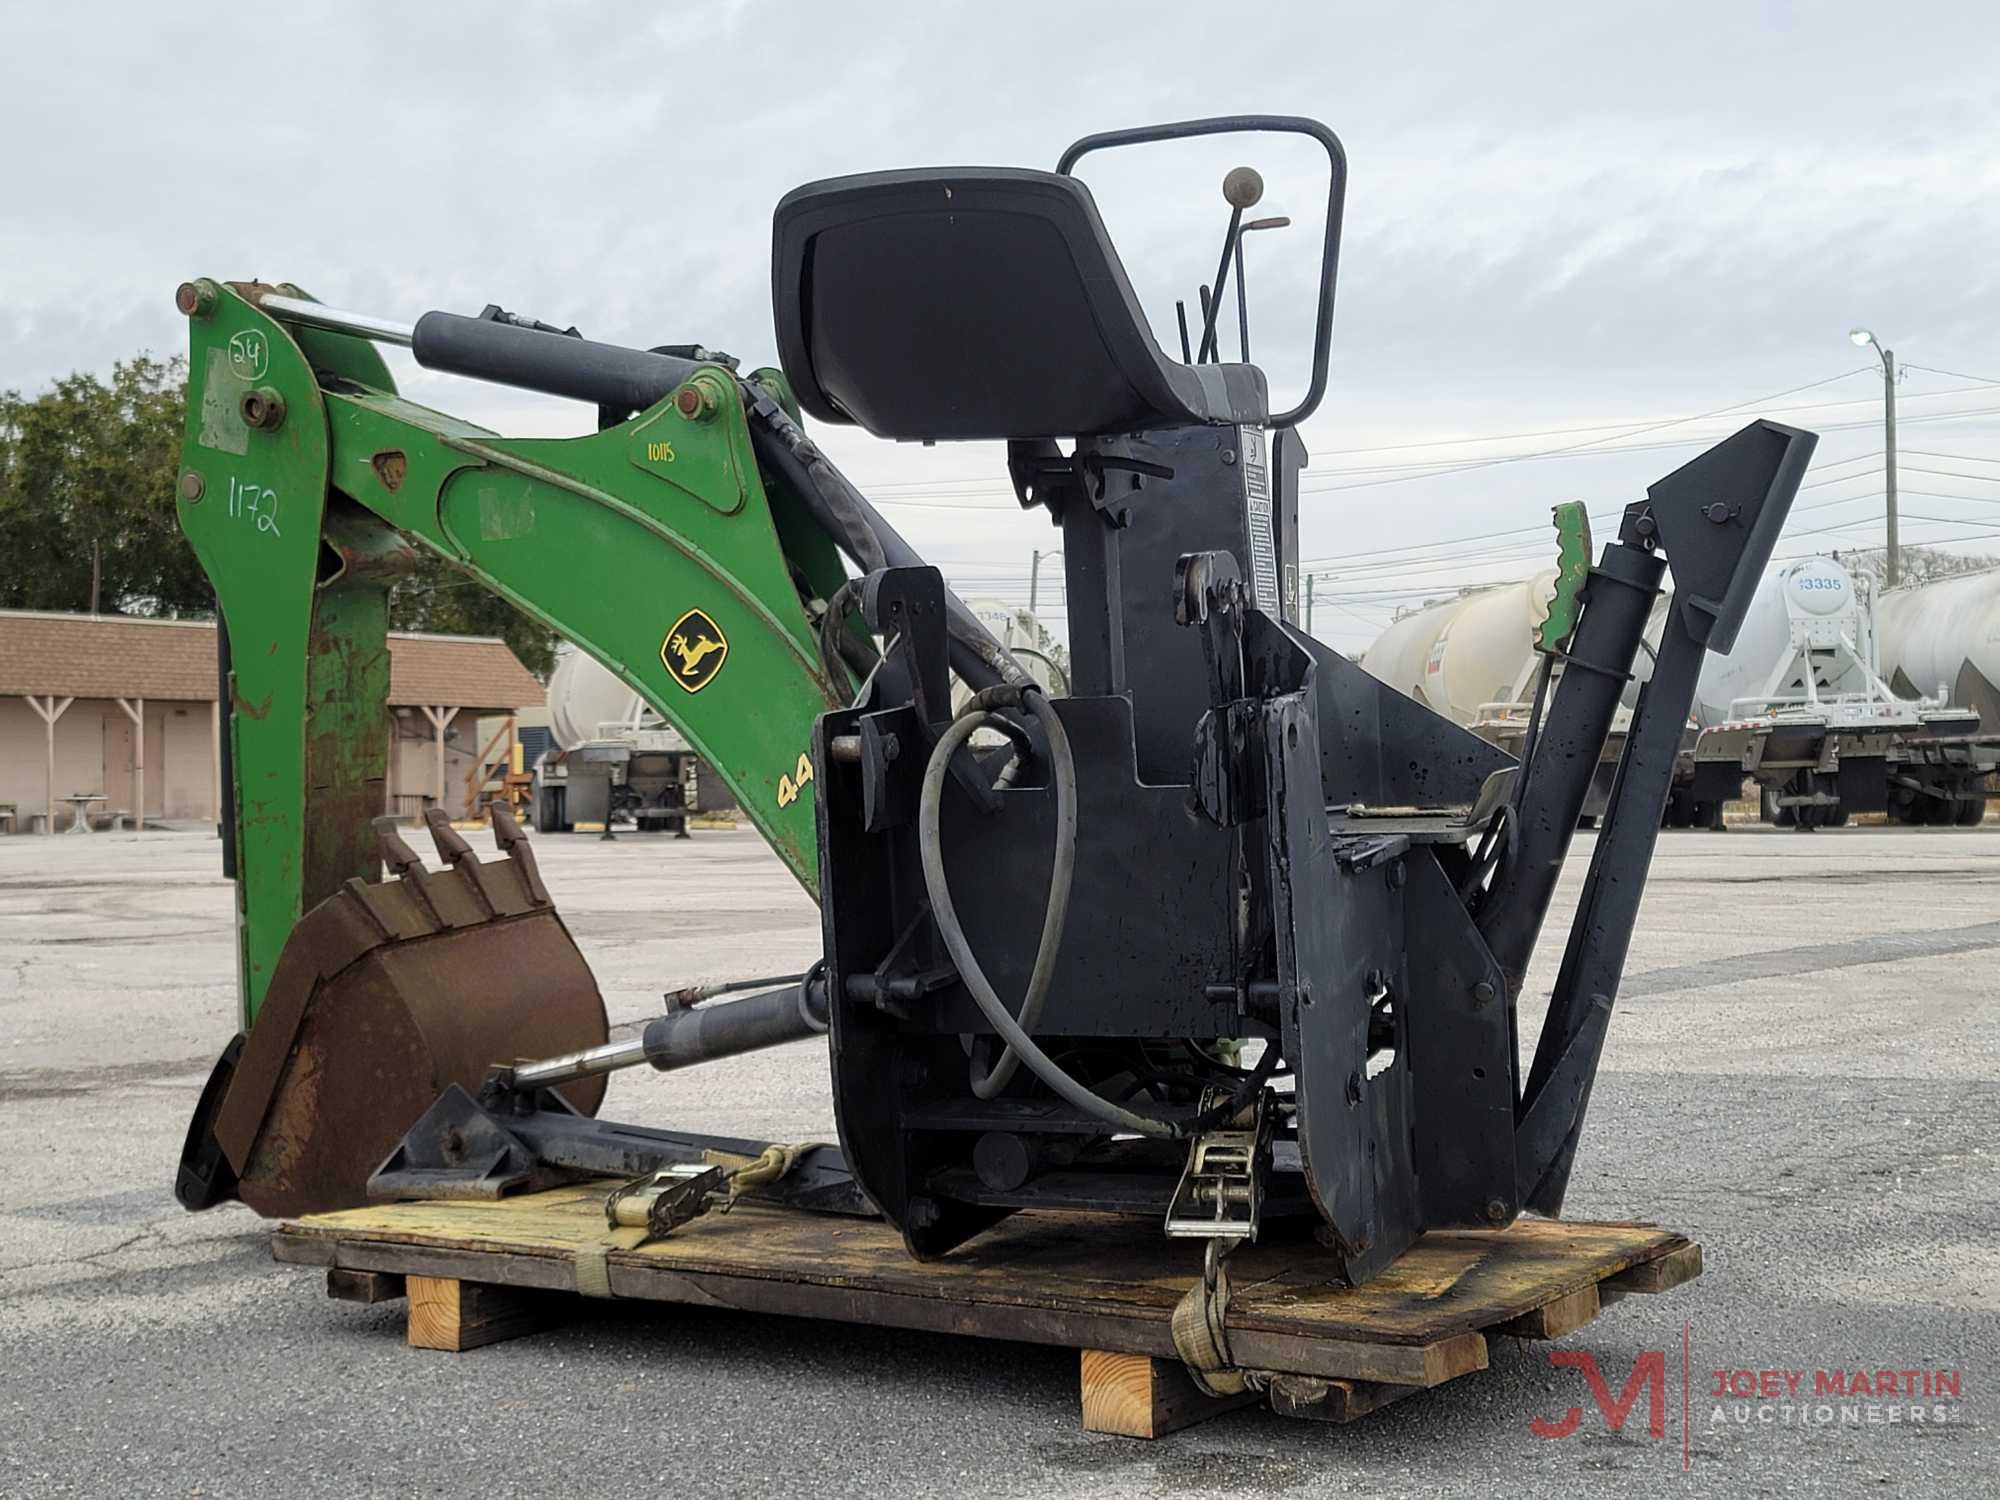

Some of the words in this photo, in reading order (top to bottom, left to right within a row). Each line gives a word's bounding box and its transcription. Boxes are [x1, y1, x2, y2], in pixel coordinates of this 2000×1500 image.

[234, 338, 260, 367] 24
[648, 441, 675, 462] 10115
[230, 476, 281, 537] 1172
